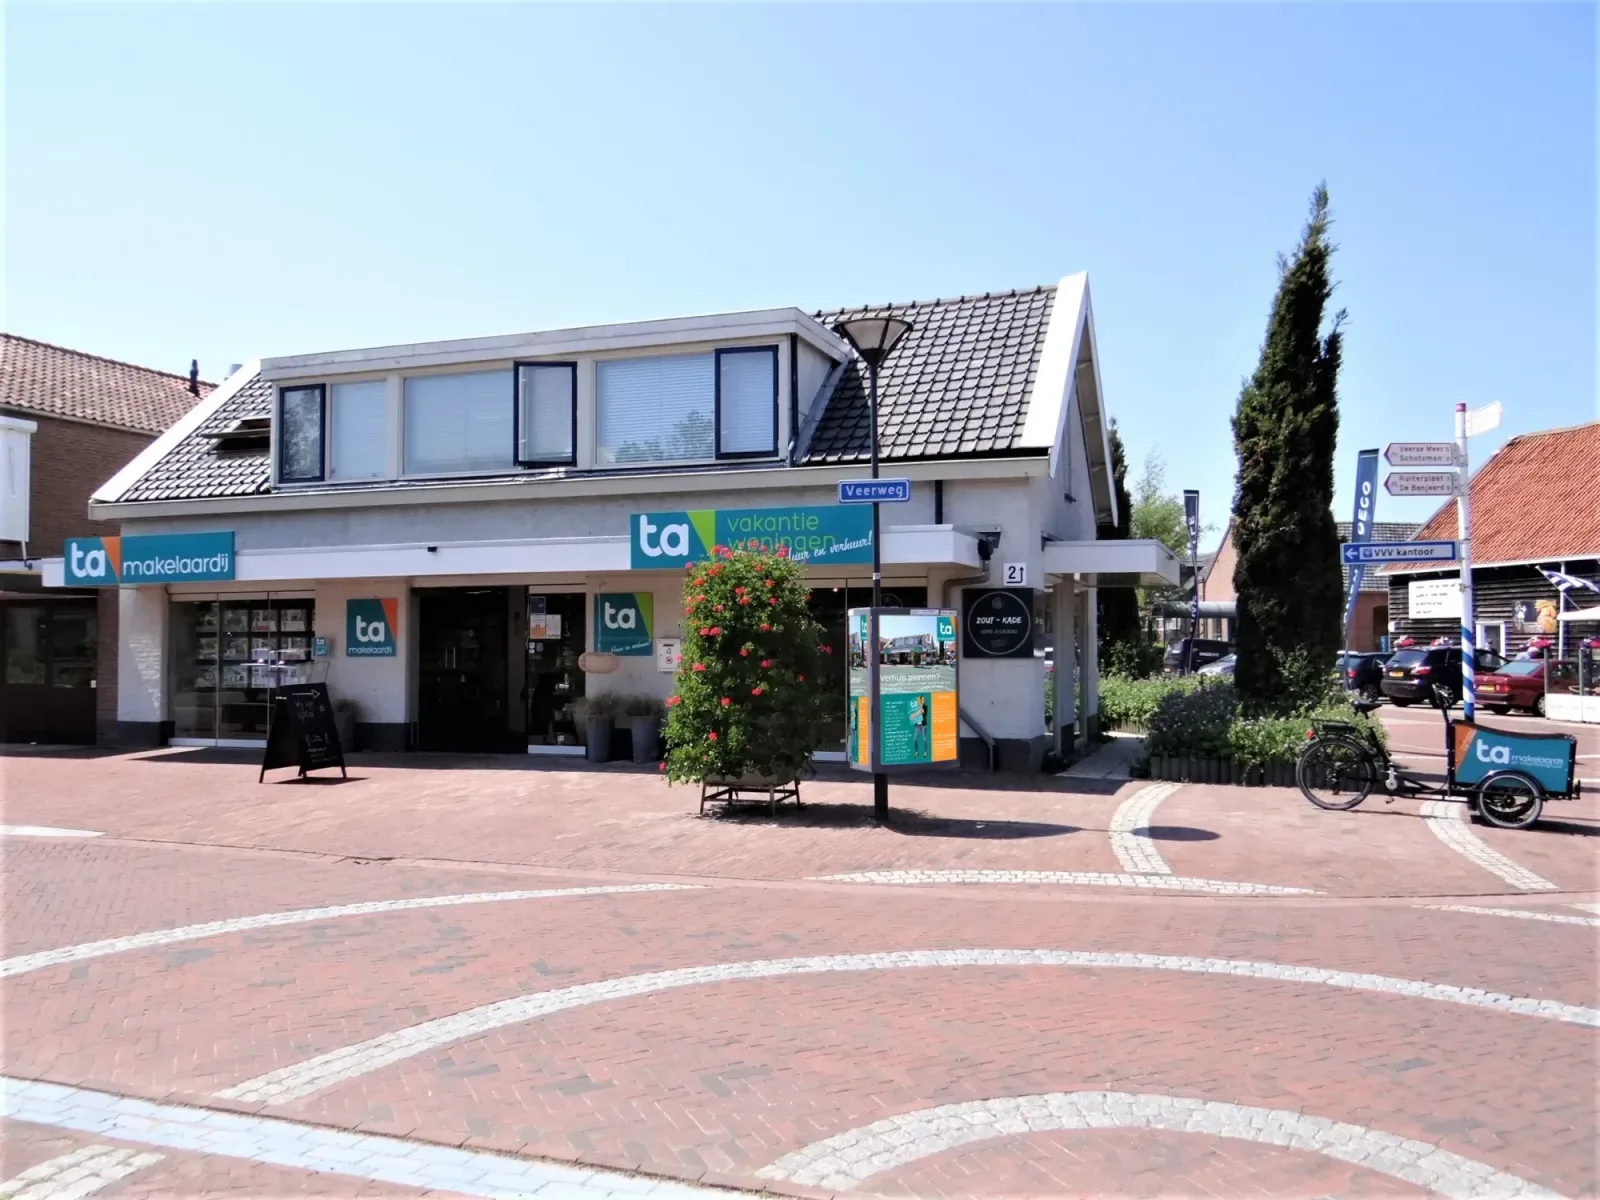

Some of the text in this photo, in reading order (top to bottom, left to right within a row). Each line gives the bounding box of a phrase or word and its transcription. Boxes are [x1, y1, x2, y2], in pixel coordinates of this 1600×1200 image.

[1399, 445, 1424, 453] Veerse
[1426, 445, 1444, 453] Meer
[1399, 475, 1444, 483] Ruiterplaat
[845, 485, 904, 498] Veerweg
[1411, 484, 1445, 493] Banjaard
[727, 512, 819, 533] vakantie
[639, 514, 689, 557] ta
[829, 530, 873, 554] verhuur!
[1373, 547, 1435, 557] VVV kantoor
[70, 542, 107, 578] ta
[122, 553, 229, 576] makelaardij
[1008, 566, 1017, 579] 2
[605, 601, 636, 630] ta
[976, 616, 995, 625] ZOUT
[1002, 616, 1022, 625] KADE
[356, 615, 385, 642] ta
[940, 621, 952, 635] ta
[348, 645, 393, 654] makelaardij
[1476, 738, 1511, 765] ta
